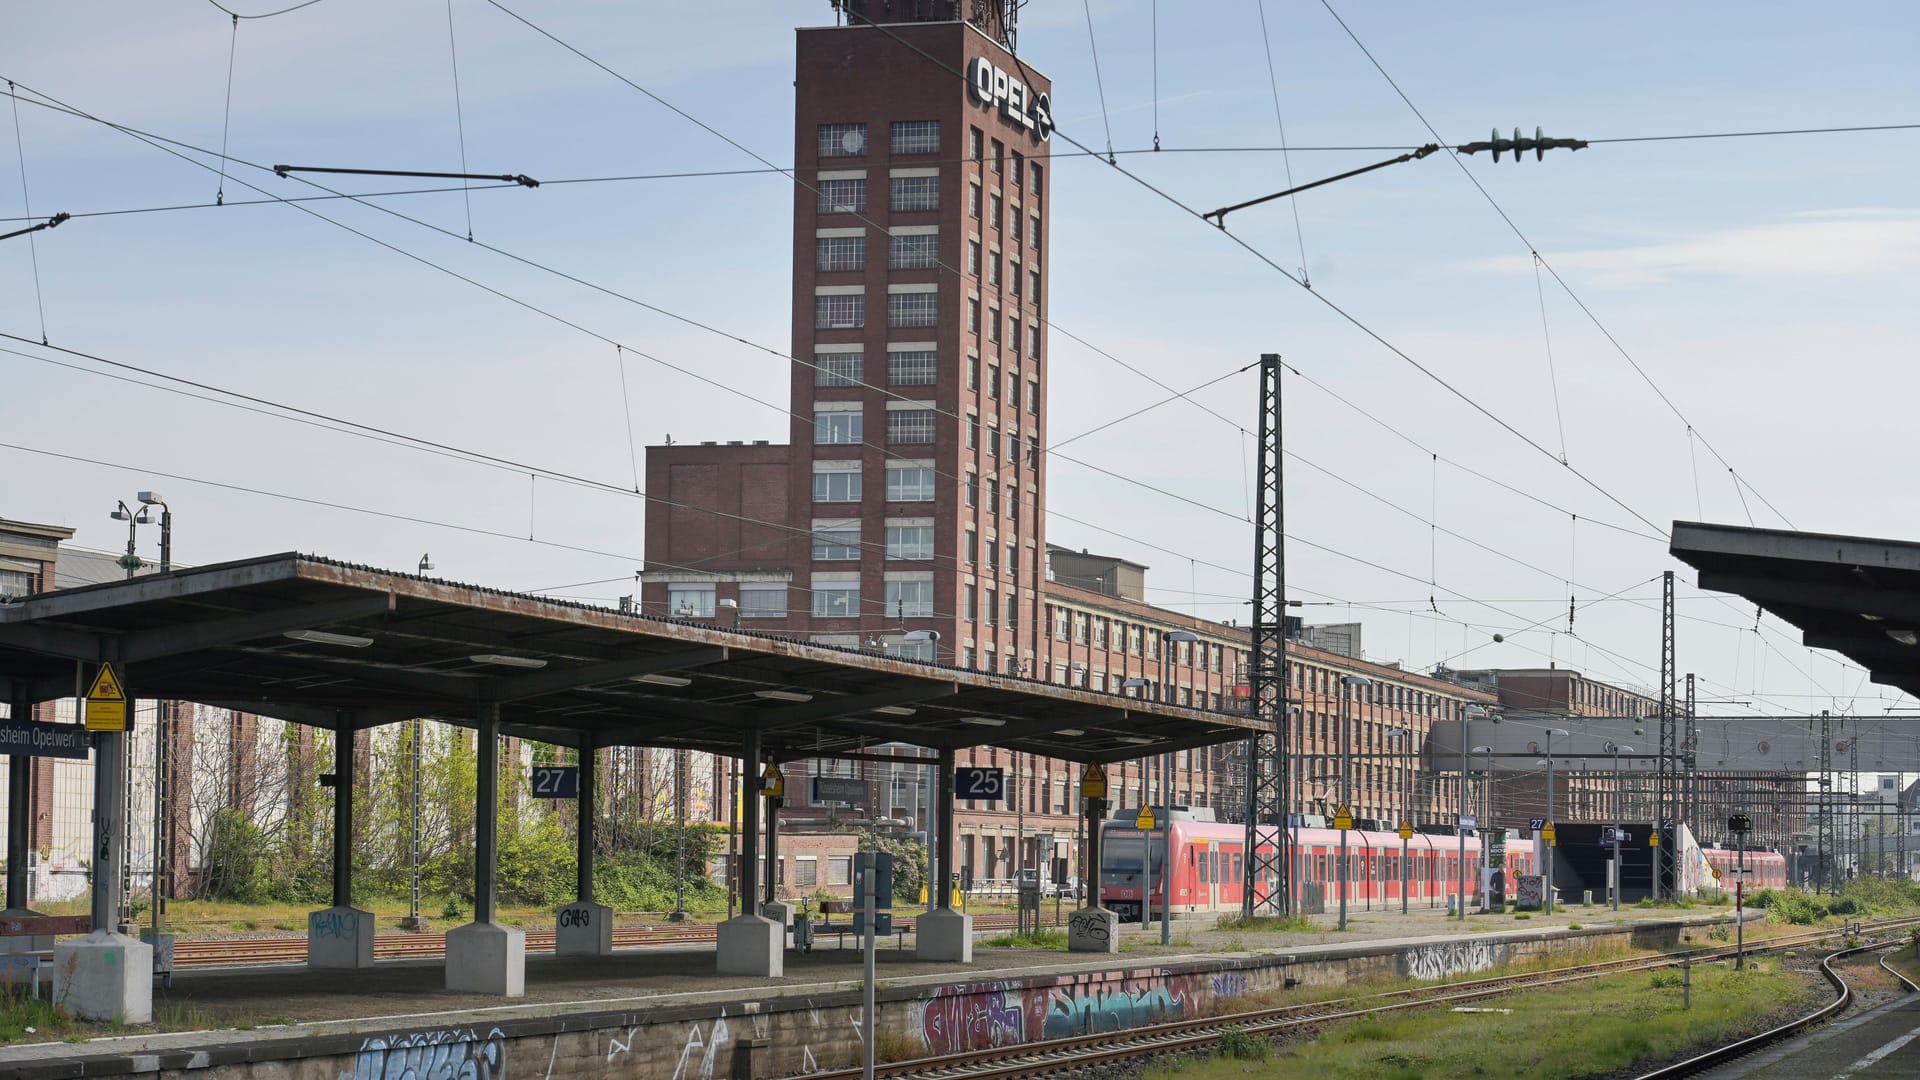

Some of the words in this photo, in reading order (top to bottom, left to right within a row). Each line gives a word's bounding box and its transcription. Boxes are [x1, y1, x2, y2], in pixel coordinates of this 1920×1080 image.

[974, 56, 1035, 130] OPEL
[0, 725, 30, 745] sheim
[32, 726, 75, 750] Opelwer
[536, 769, 565, 793] 27
[970, 769, 999, 794] 25
[1530, 819, 1544, 829] 27
